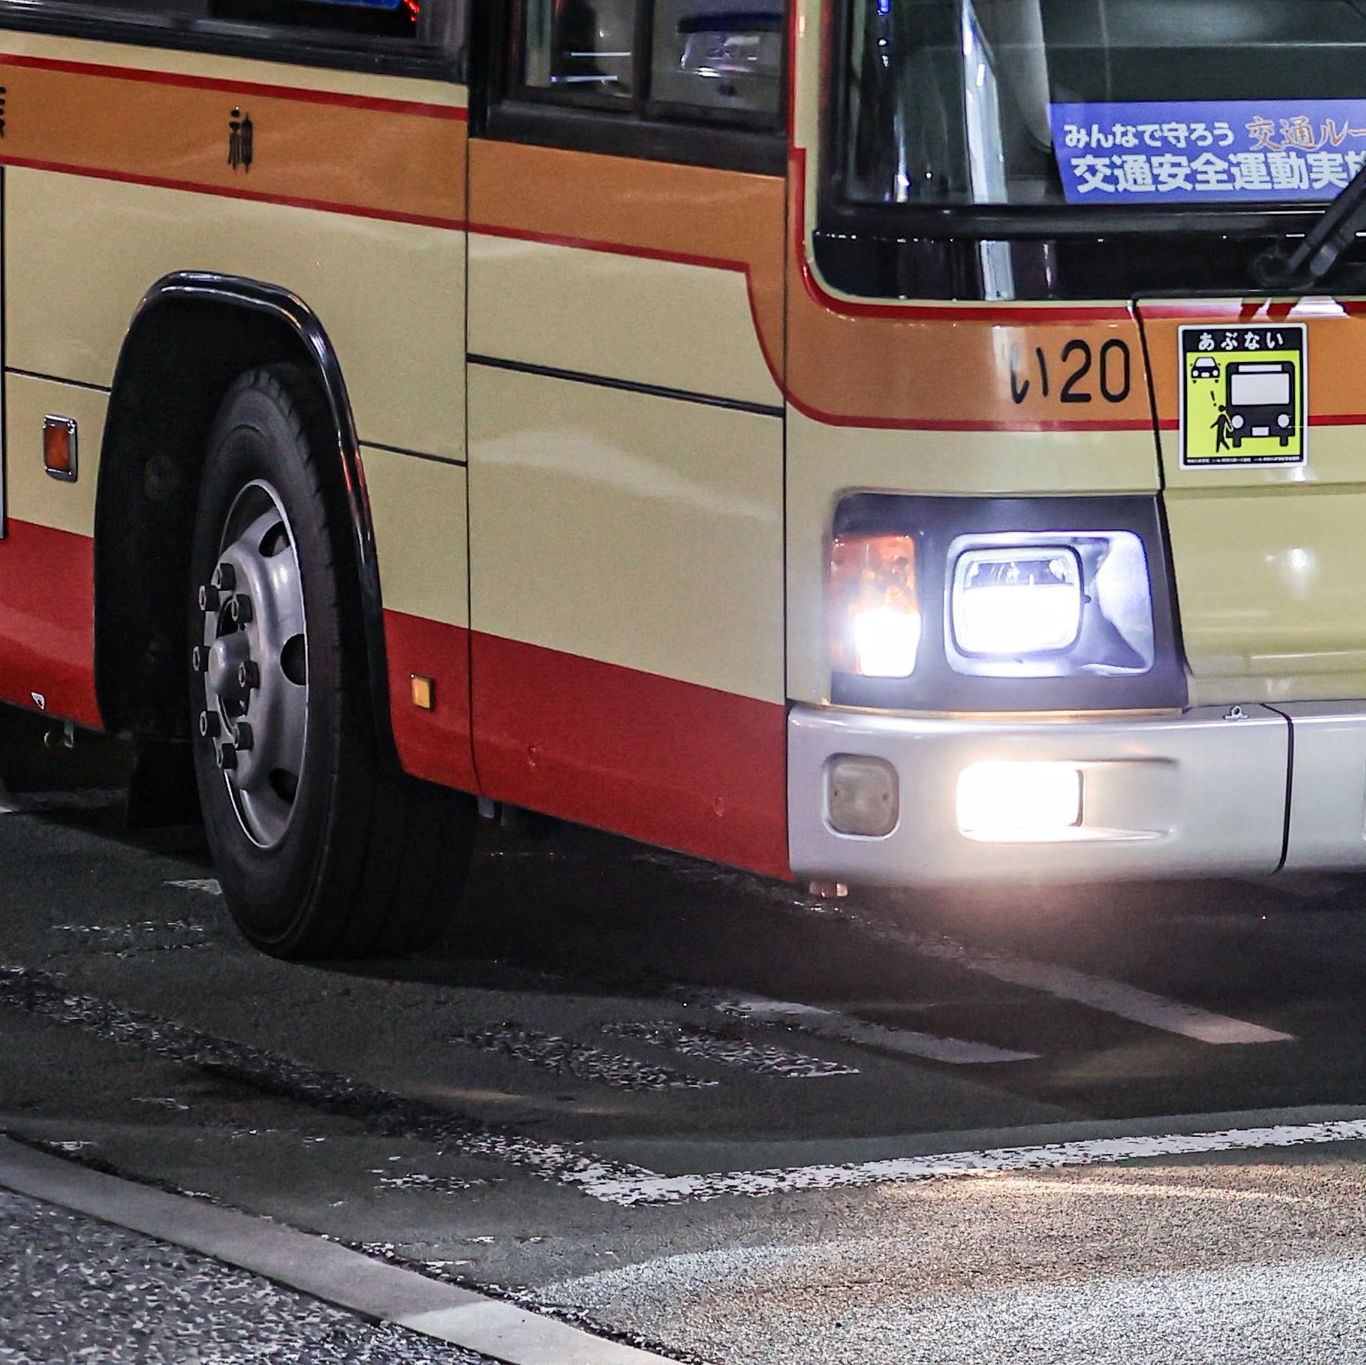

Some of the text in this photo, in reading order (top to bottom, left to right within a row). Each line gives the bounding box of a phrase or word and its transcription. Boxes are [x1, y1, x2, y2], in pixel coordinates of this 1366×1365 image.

[1063, 122, 1235, 149] みんなで守ろう
[1197, 331, 1284, 351] あぶない
[1009, 338, 1131, 405] い20
